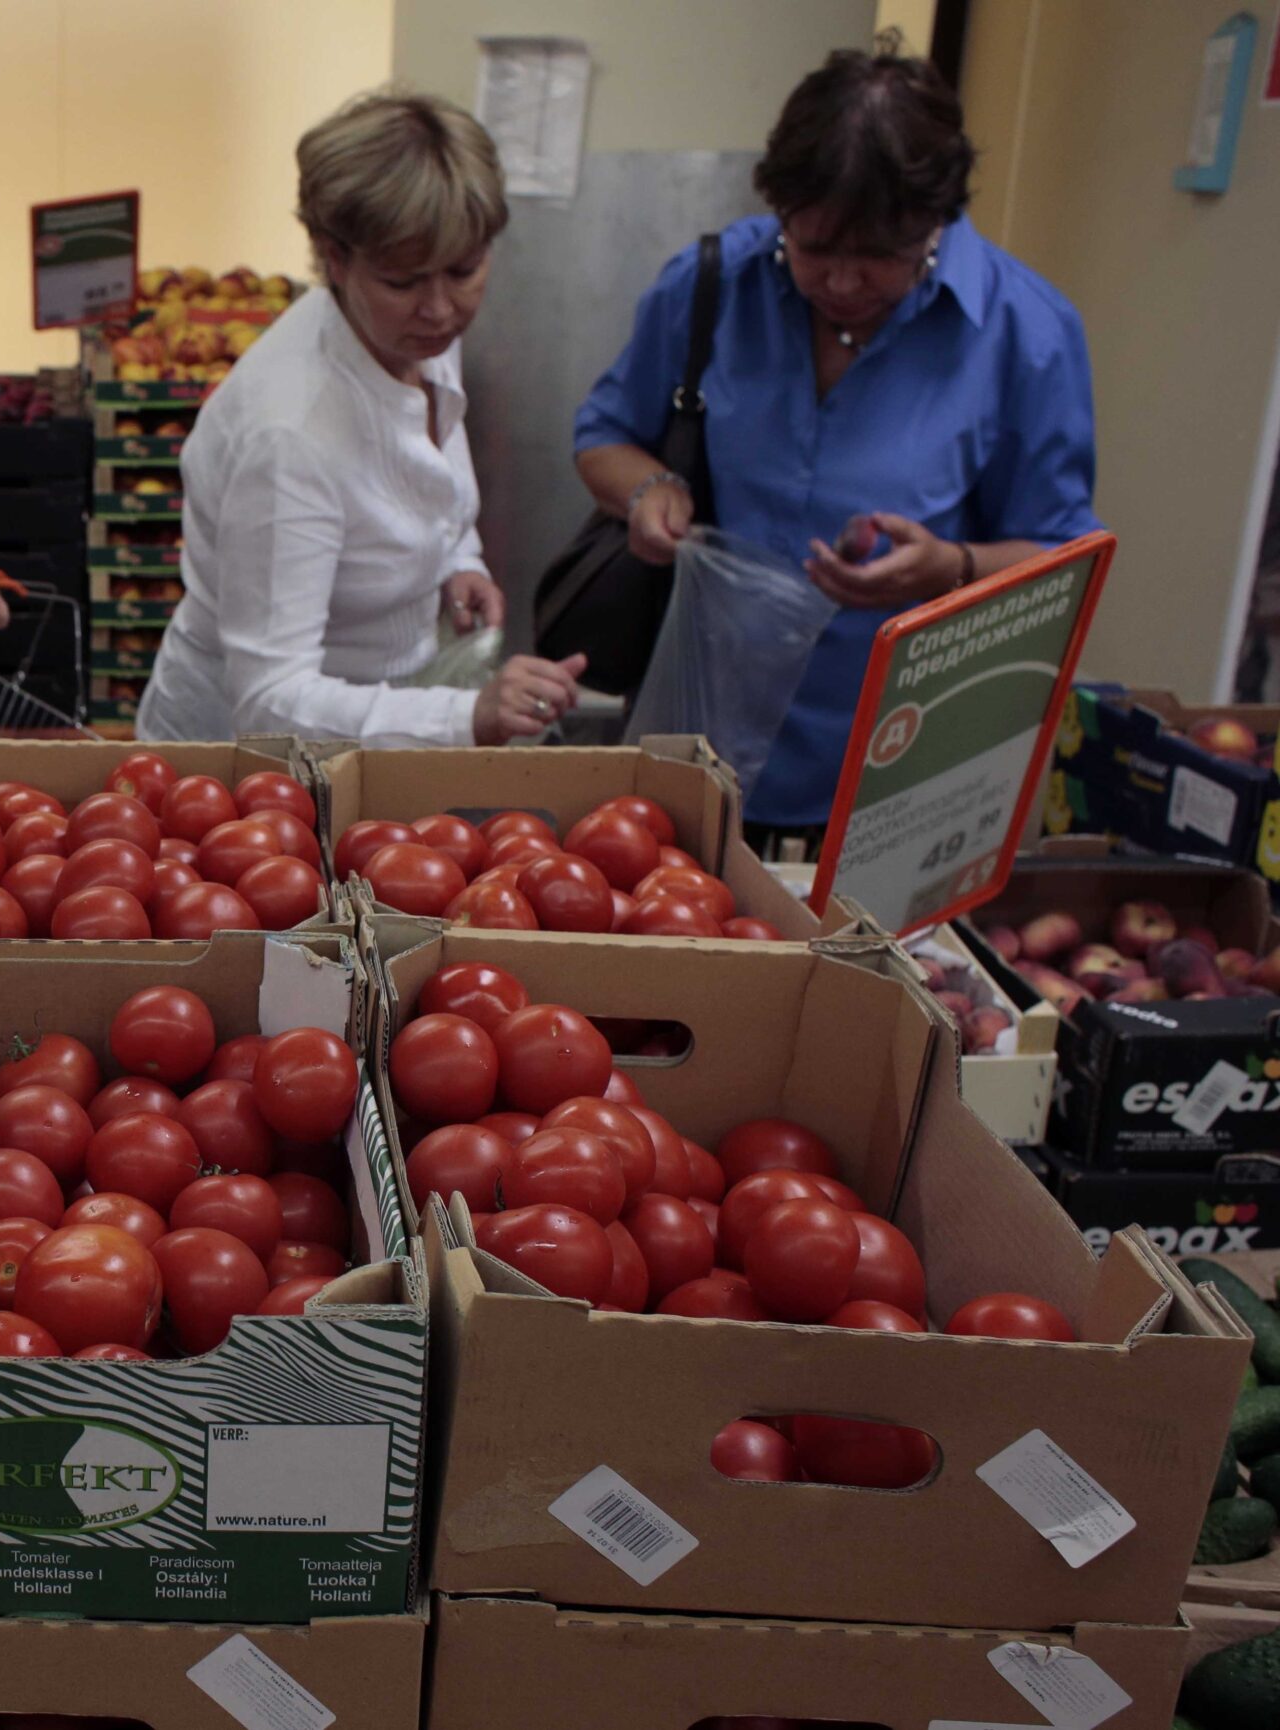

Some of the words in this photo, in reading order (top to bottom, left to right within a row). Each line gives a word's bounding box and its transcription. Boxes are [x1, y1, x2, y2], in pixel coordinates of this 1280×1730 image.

[907, 571, 1075, 661] Специальное
[897, 596, 1070, 690] предложение
[1081, 1225, 1262, 1257] epax
[212, 1427, 250, 1441] VERP.:
[56, 1503, 140, 1526] TOMATES
[215, 1514, 327, 1527] www.nature.nl
[10, 1550, 72, 1565] Tomater
[149, 1555, 236, 1569] Paradicsom
[299, 1557, 383, 1573] Tomaatteja
[155, 1570, 219, 1587] Osztály:
[307, 1573, 368, 1587] Luokka
[13, 1581, 73, 1595] Holland
[155, 1586, 228, 1600] Hollandia
[309, 1589, 373, 1602] Hollanti
